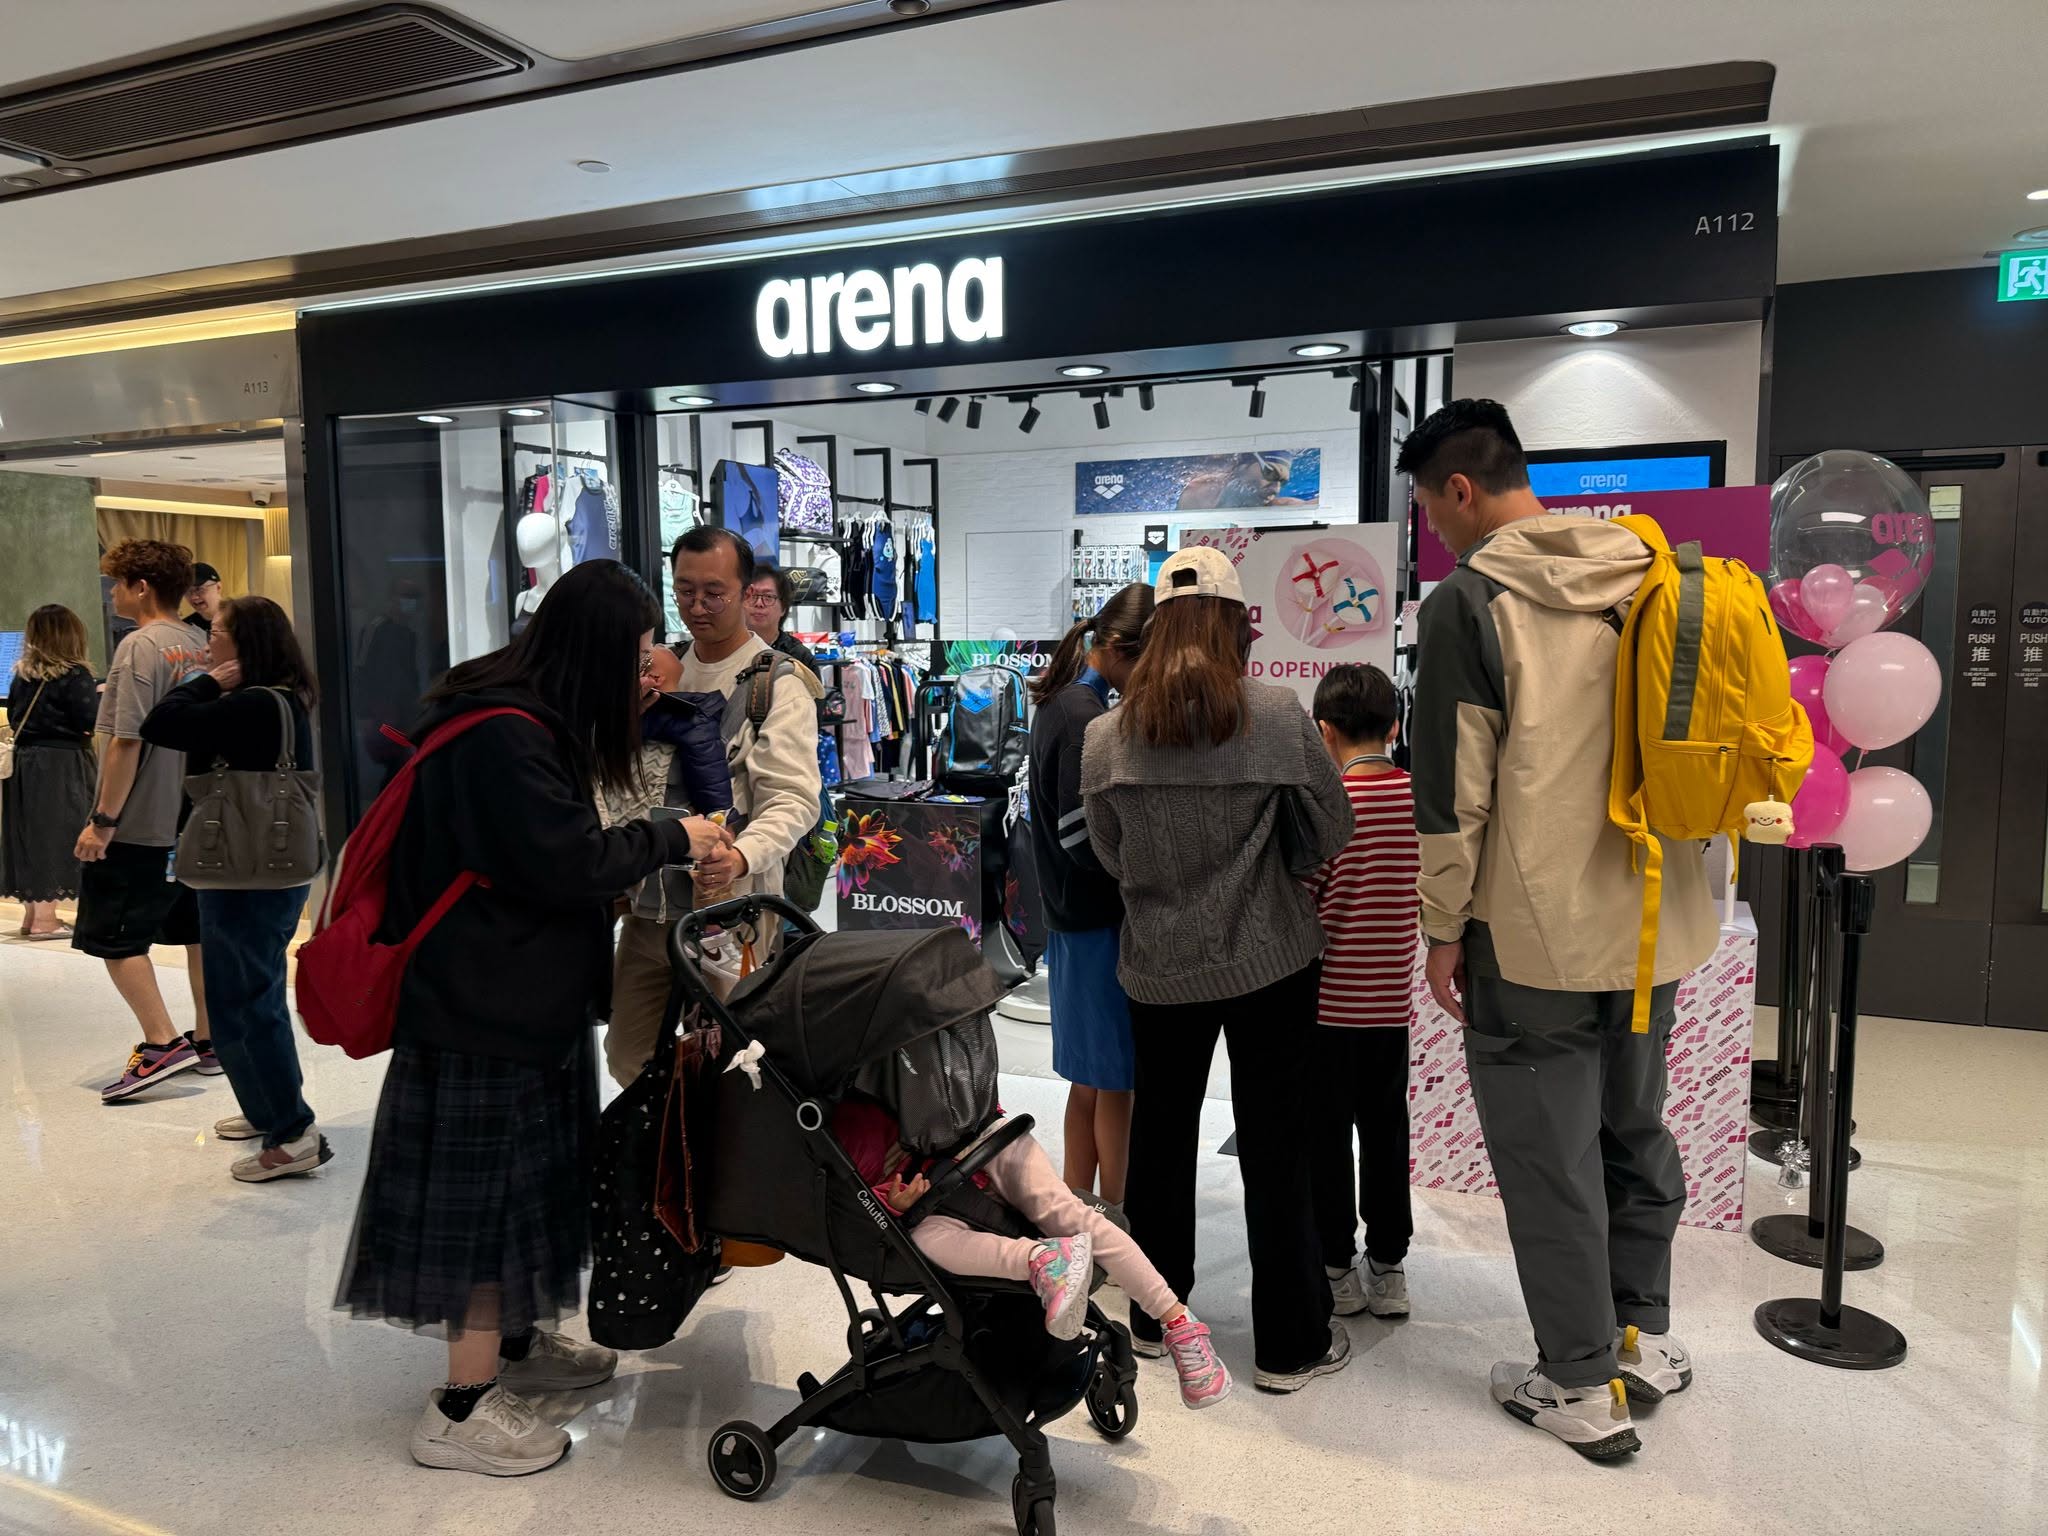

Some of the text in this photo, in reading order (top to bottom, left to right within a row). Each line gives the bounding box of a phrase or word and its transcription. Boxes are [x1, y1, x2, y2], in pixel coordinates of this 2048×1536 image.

[1694, 212, 1755, 236] A112
[756, 256, 1003, 358] arena
[243, 381, 269, 394] A113
[1094, 474, 1124, 485] arena
[1579, 474, 1628, 488] arena
[1970, 617, 1997, 625] AUTO
[2022, 616, 2048, 624] AUTO
[1968, 633, 1996, 644] PUSH
[2020, 633, 2048, 644] PUSH
[1971, 646, 1991, 662] 推
[2023, 646, 2043, 662] 推
[851, 892, 964, 918] BLOSSOM
[1709, 986, 1736, 1008] arena
[1720, 1007, 1744, 1027] arena
[1670, 1016, 1699, 1040] arena
[1423, 1029, 1448, 1051] arena
[1418, 1058, 1442, 1080] arena
[1665, 1047, 1693, 1071] arena
[1705, 1065, 1733, 1087] arena
[1667, 1094, 1696, 1118] arena
[1716, 1087, 1741, 1106] arena
[1422, 1103, 1446, 1124] arena
[1417, 1132, 1441, 1153] arena
[1702, 1144, 1729, 1165] arena
[1464, 1170, 1485, 1187] arena
[1713, 1165, 1737, 1184] arena
[856, 1189, 889, 1231] Calutte
